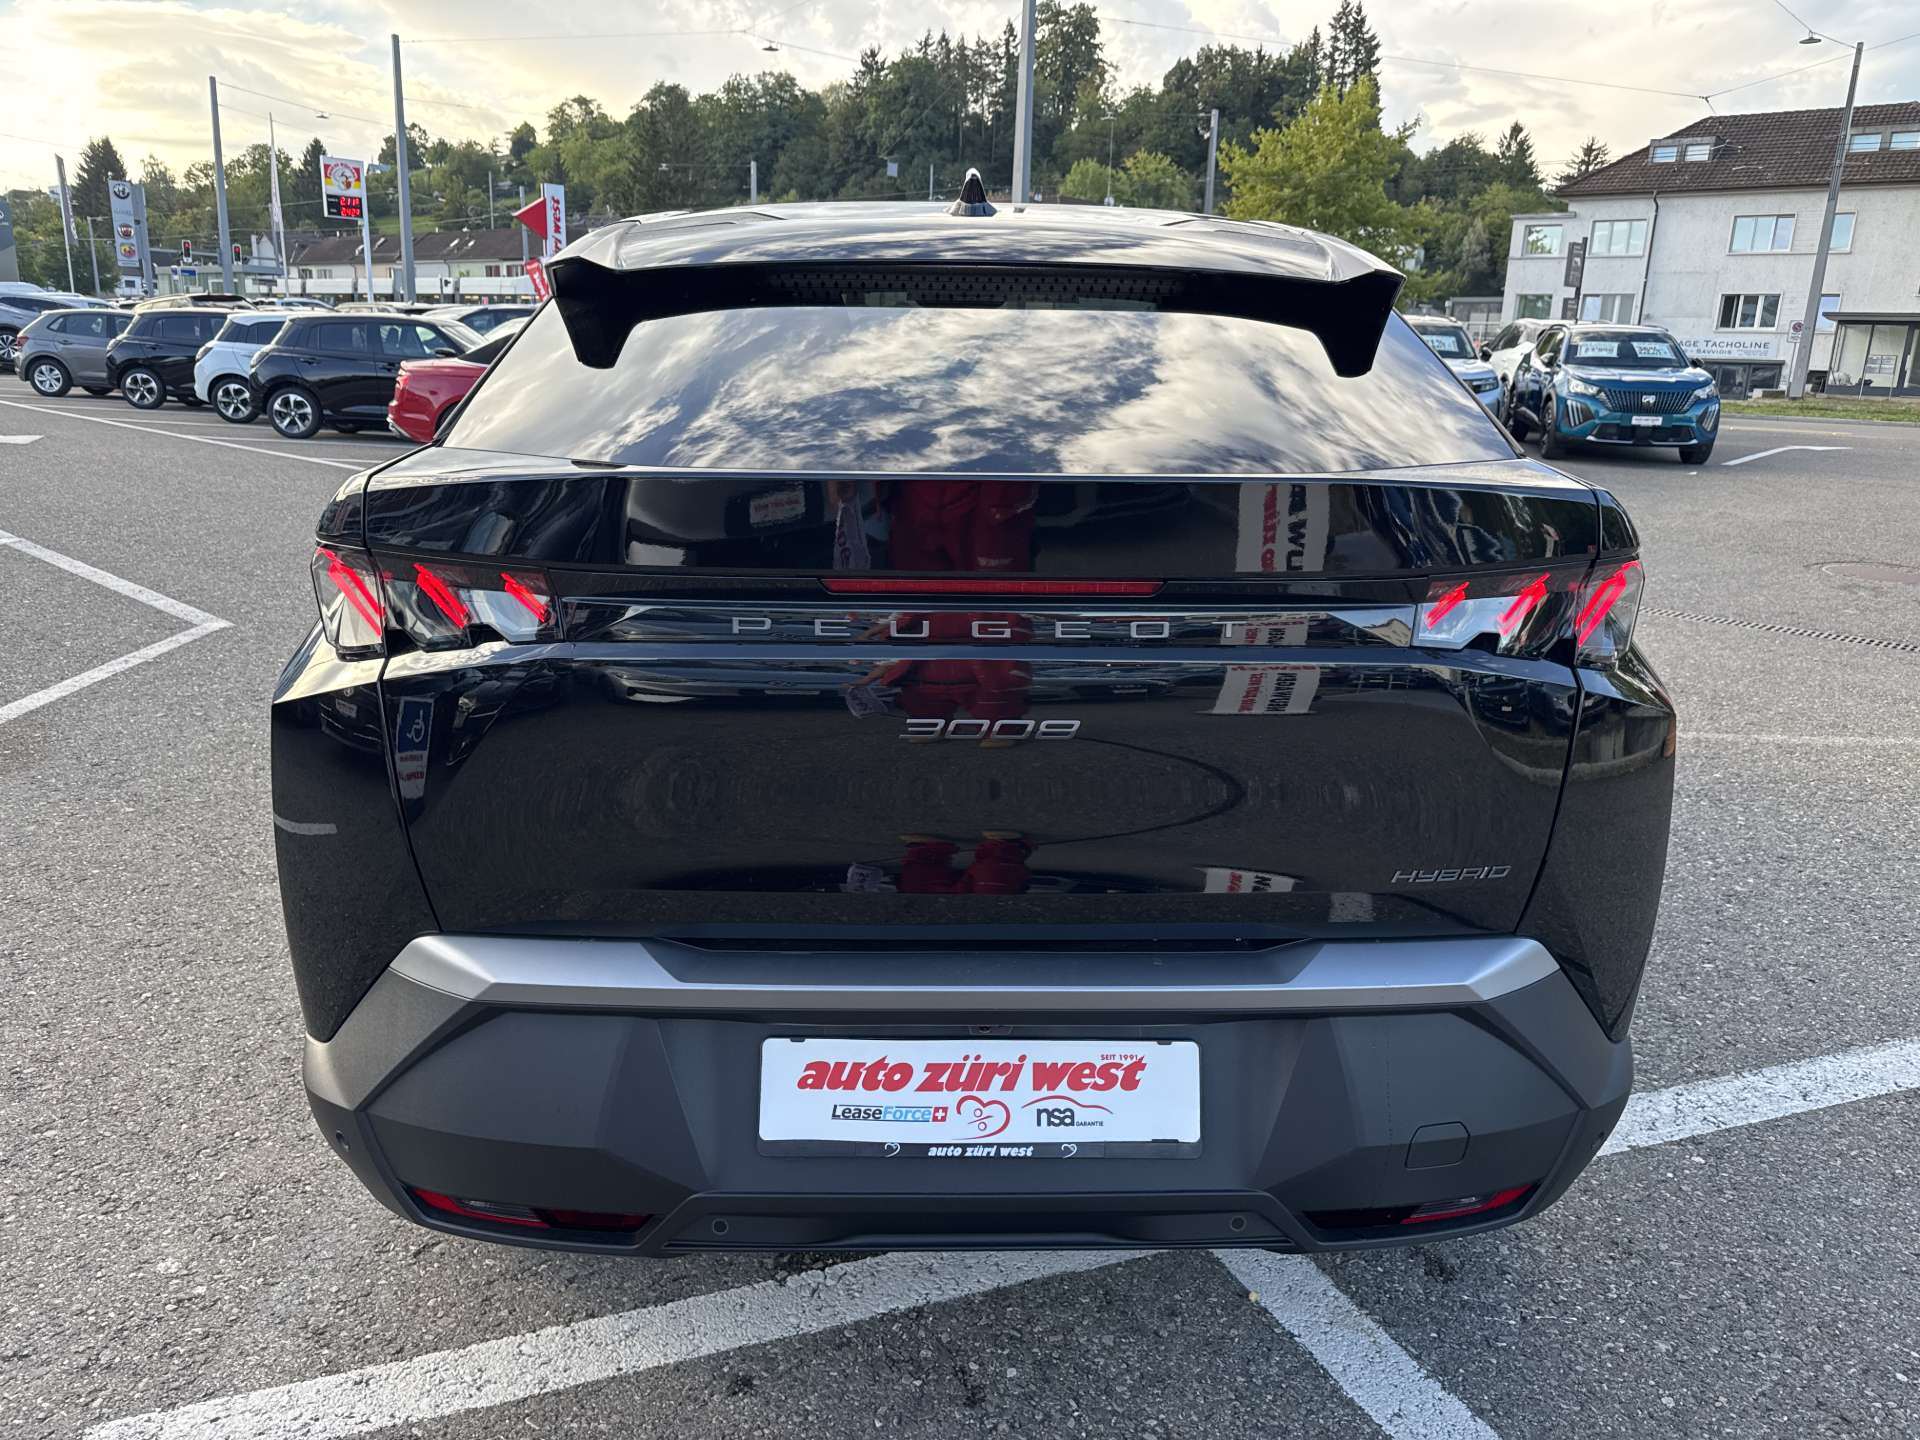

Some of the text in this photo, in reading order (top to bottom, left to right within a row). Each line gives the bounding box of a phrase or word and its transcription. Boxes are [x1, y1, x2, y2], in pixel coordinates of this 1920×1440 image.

[1703, 339, 1770, 349] TACHOLINE
[731, 616, 1246, 639] PEUGEOT
[899, 718, 1081, 740] 3008
[1391, 865, 1512, 883] HYBRID
[1100, 1053, 1138, 1061] SEIT 1991
[797, 1054, 1147, 1092] auto züri west
[831, 1104, 932, 1121] LeaseForce
[1036, 1107, 1075, 1128] nsa
[927, 1144, 1034, 1157] auto züri west
